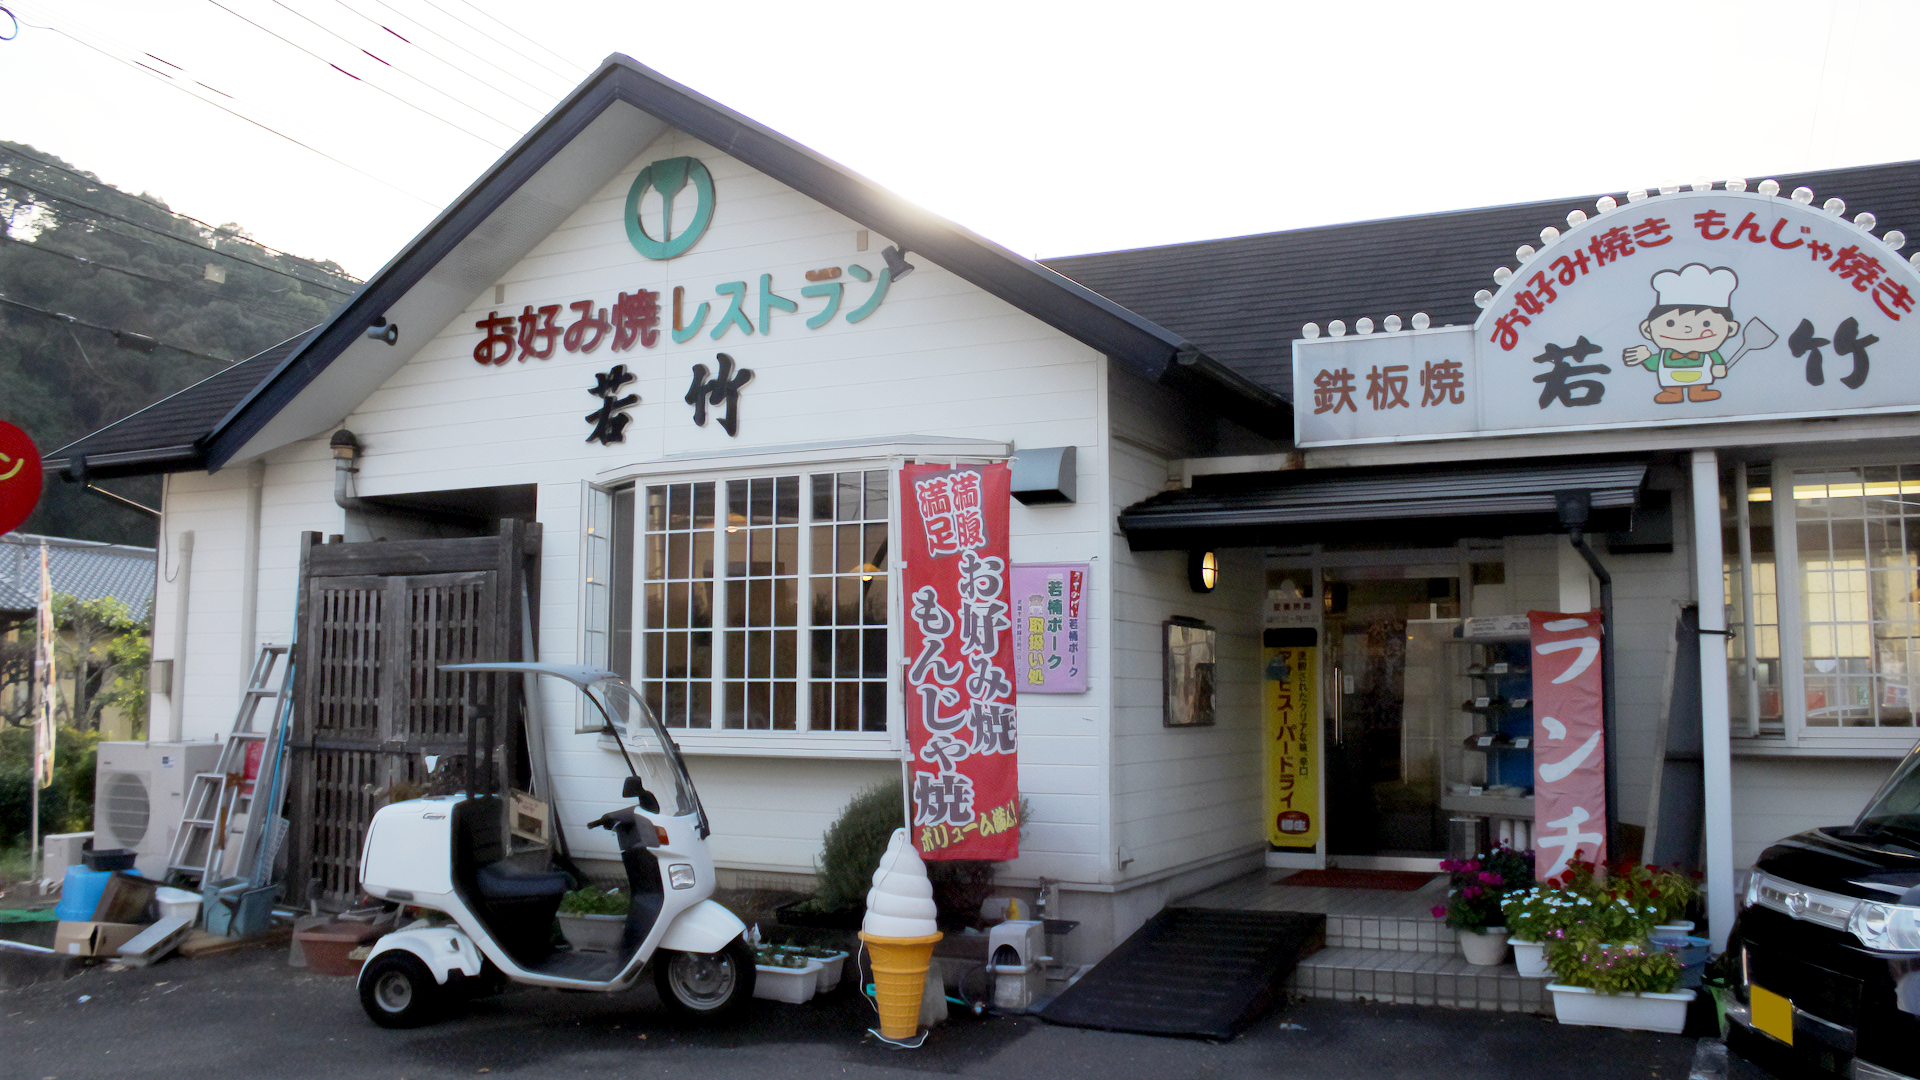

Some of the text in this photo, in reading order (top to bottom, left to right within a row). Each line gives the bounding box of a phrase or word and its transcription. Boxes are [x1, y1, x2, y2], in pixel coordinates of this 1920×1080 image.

[1490, 209, 1917, 352] お好み焼き もんじゃ焼き
[1313, 359, 1466, 416] 鉄板焼
[910, 585, 975, 826] もんじゃ焼
[959, 551, 1017, 755] お好み焼
[1277, 651, 1296, 809] アヒスーパードライ
[1535, 617, 1604, 878] ランチ
